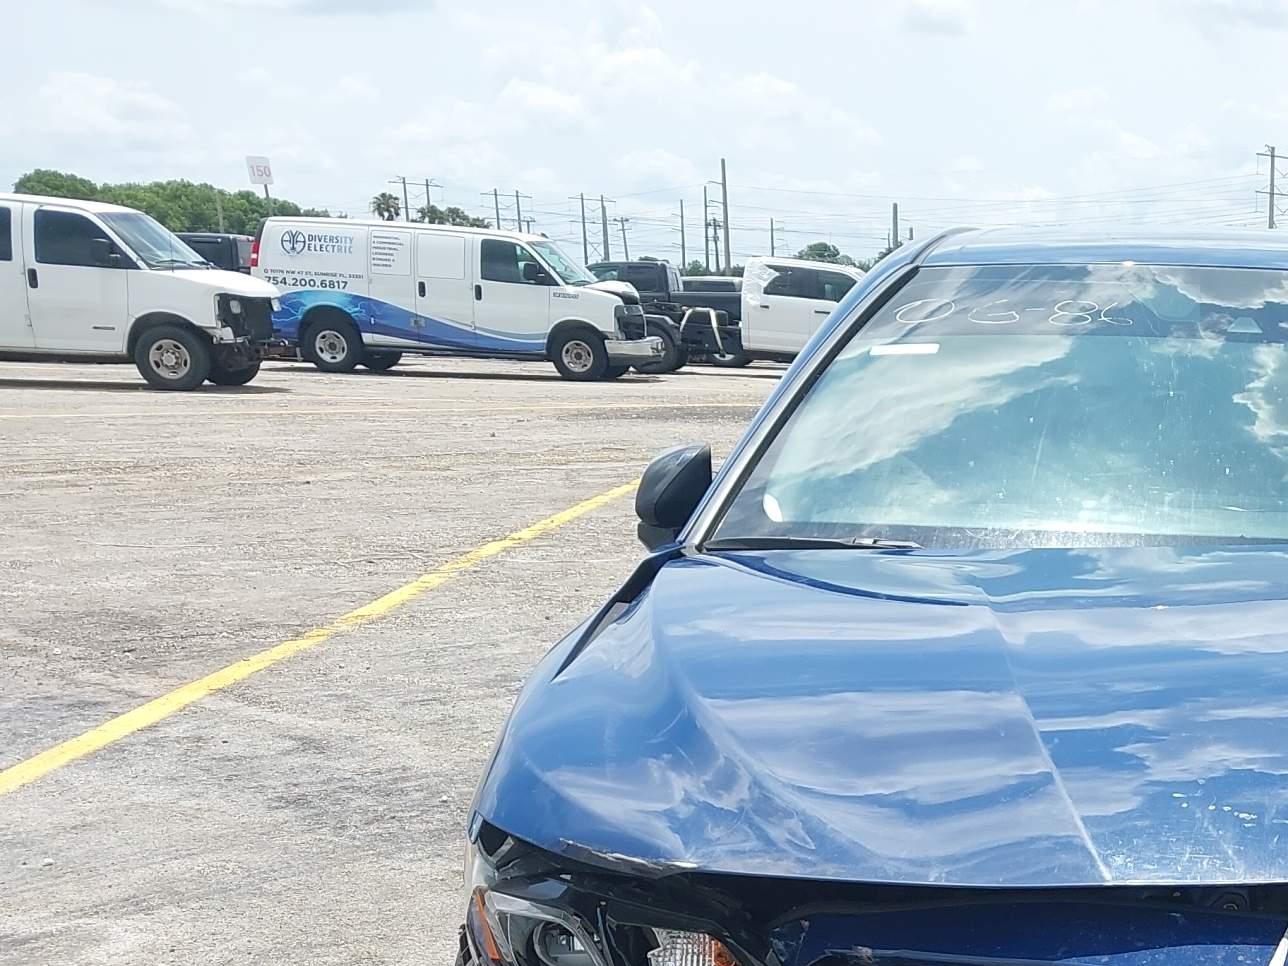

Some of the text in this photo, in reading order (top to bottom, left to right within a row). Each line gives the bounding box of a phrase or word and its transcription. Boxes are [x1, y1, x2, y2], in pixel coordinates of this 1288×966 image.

[250, 165, 272, 177] 150
[307, 233, 353, 244] DIVERSITY
[307, 243, 353, 254] ELECTRIC
[265, 275, 348, 290] 754.200.6817
